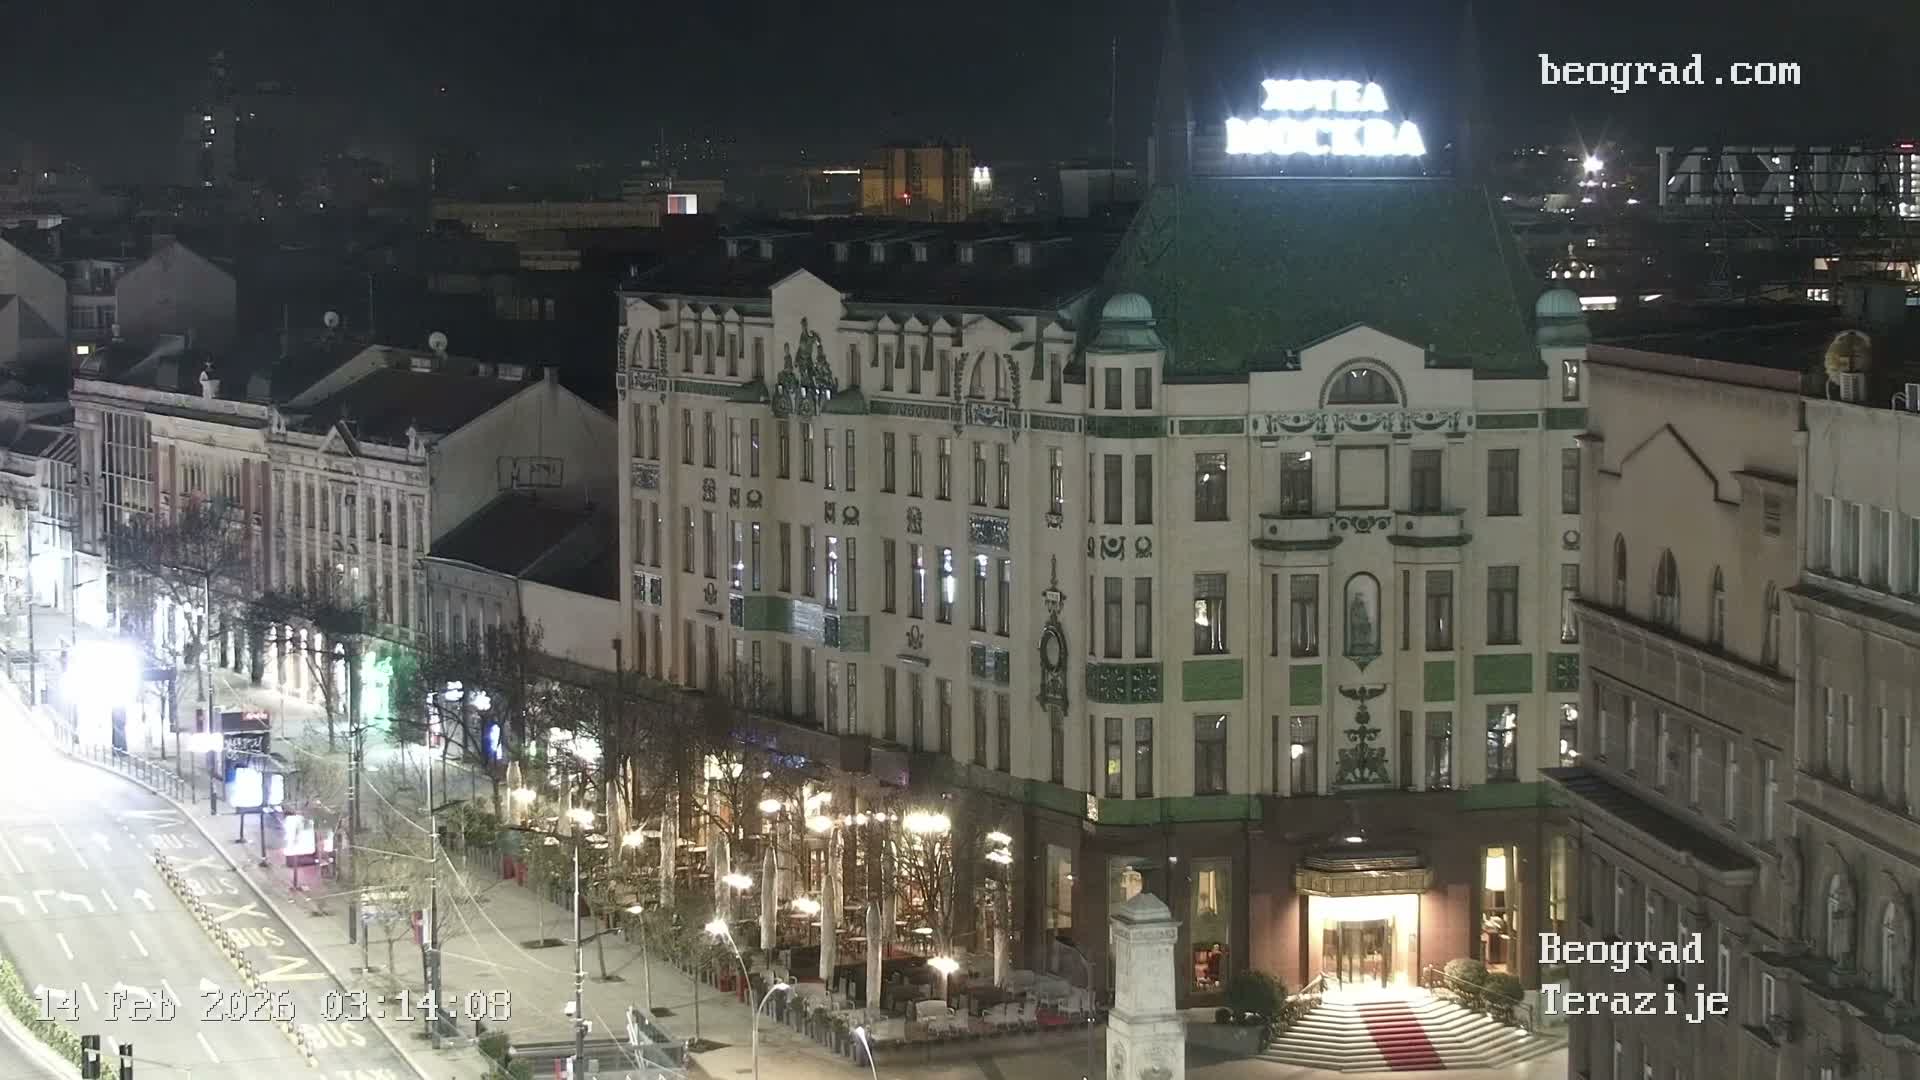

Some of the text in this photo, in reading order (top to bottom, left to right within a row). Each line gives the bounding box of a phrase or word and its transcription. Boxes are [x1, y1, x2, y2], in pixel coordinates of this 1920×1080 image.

[184, 877, 240, 896] BUS
[226, 925, 287, 949] BUS
[297, 1021, 367, 1048] BUS
